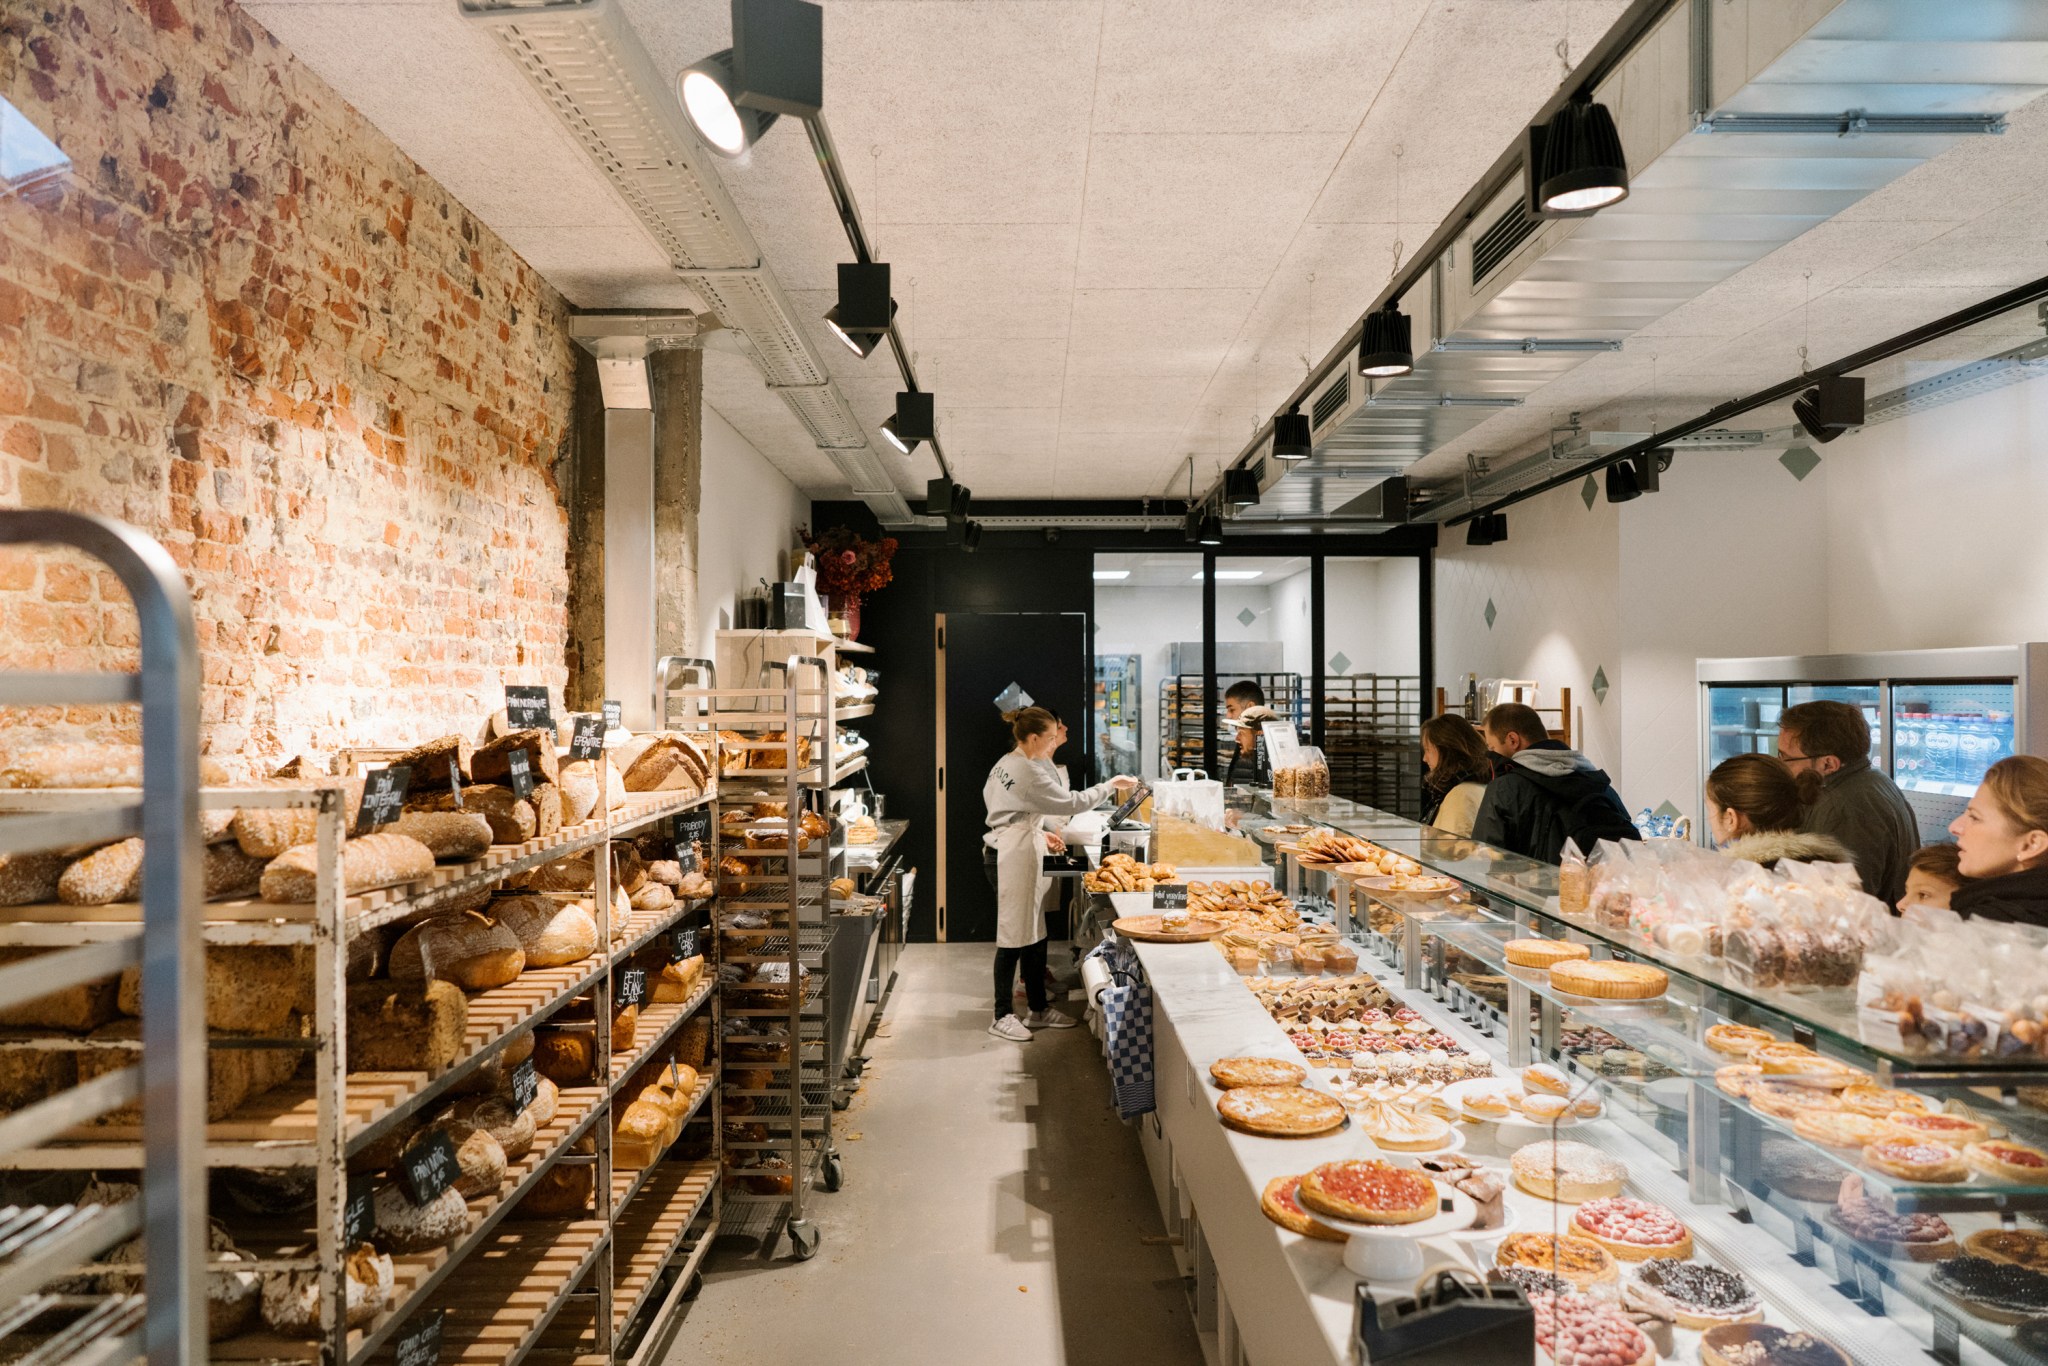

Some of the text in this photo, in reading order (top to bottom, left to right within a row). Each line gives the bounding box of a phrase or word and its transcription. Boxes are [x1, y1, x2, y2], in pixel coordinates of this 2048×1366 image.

[678, 929, 696, 943] PETIT
[624, 969, 644, 984] PETIT
[623, 982, 644, 996] BLANC
[413, 1159, 432, 1182] PAIN
